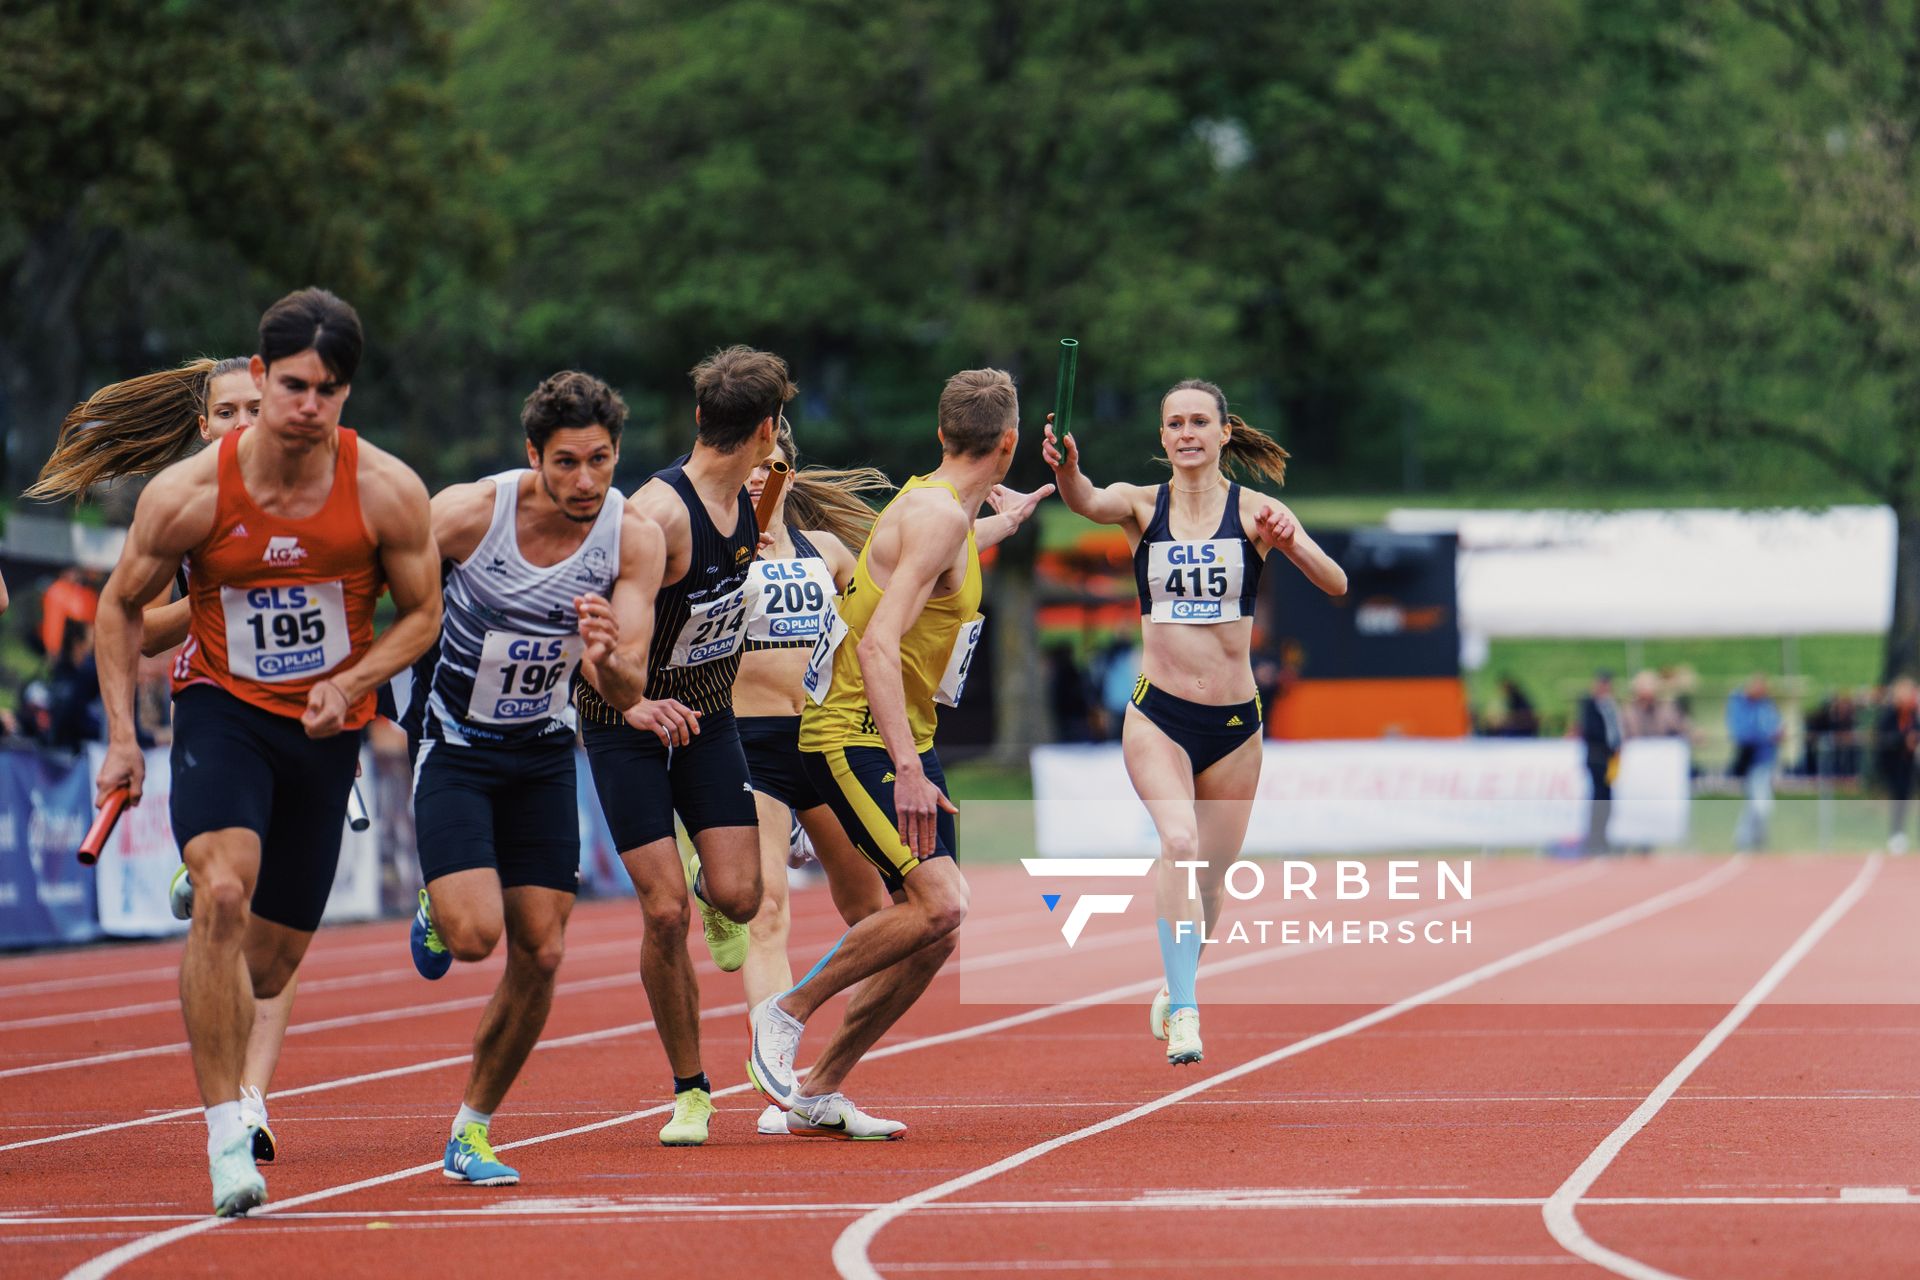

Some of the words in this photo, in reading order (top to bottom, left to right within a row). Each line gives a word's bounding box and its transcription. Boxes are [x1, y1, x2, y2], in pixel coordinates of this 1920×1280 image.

[1165, 567, 1228, 597] 415
[764, 582, 824, 614] 209
[247, 609, 325, 650] 195
[690, 607, 747, 646] 214
[791, 618, 818, 629] PLAN
[284, 650, 321, 667] PLAN
[708, 639, 733, 655] PLAN
[500, 661, 566, 695] 196
